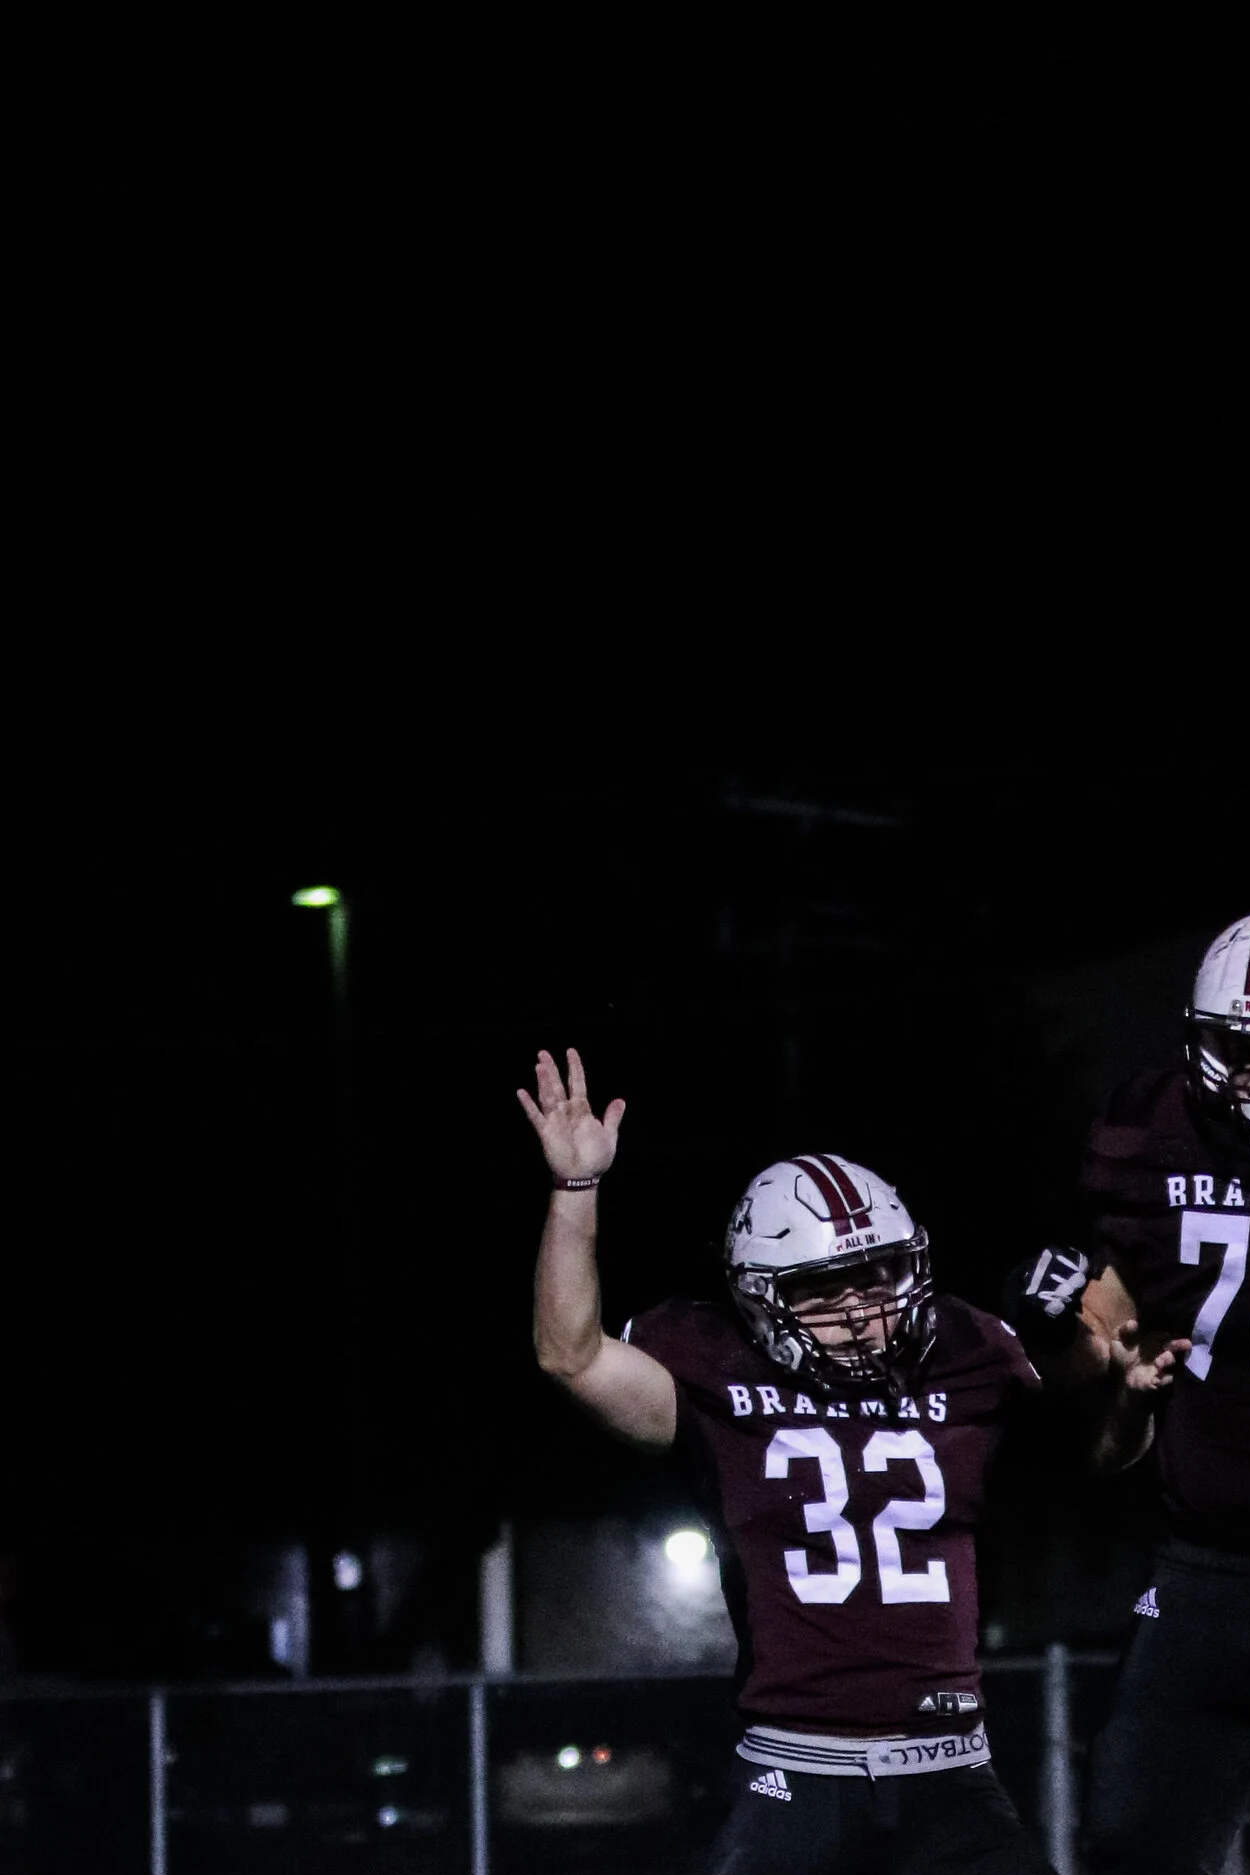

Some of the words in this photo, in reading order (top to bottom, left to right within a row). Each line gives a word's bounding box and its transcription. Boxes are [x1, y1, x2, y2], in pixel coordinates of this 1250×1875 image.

[845, 1235, 863, 1249] ALL
[764, 1427, 950, 1604] 32
[750, 1781, 792, 1802] adidas
